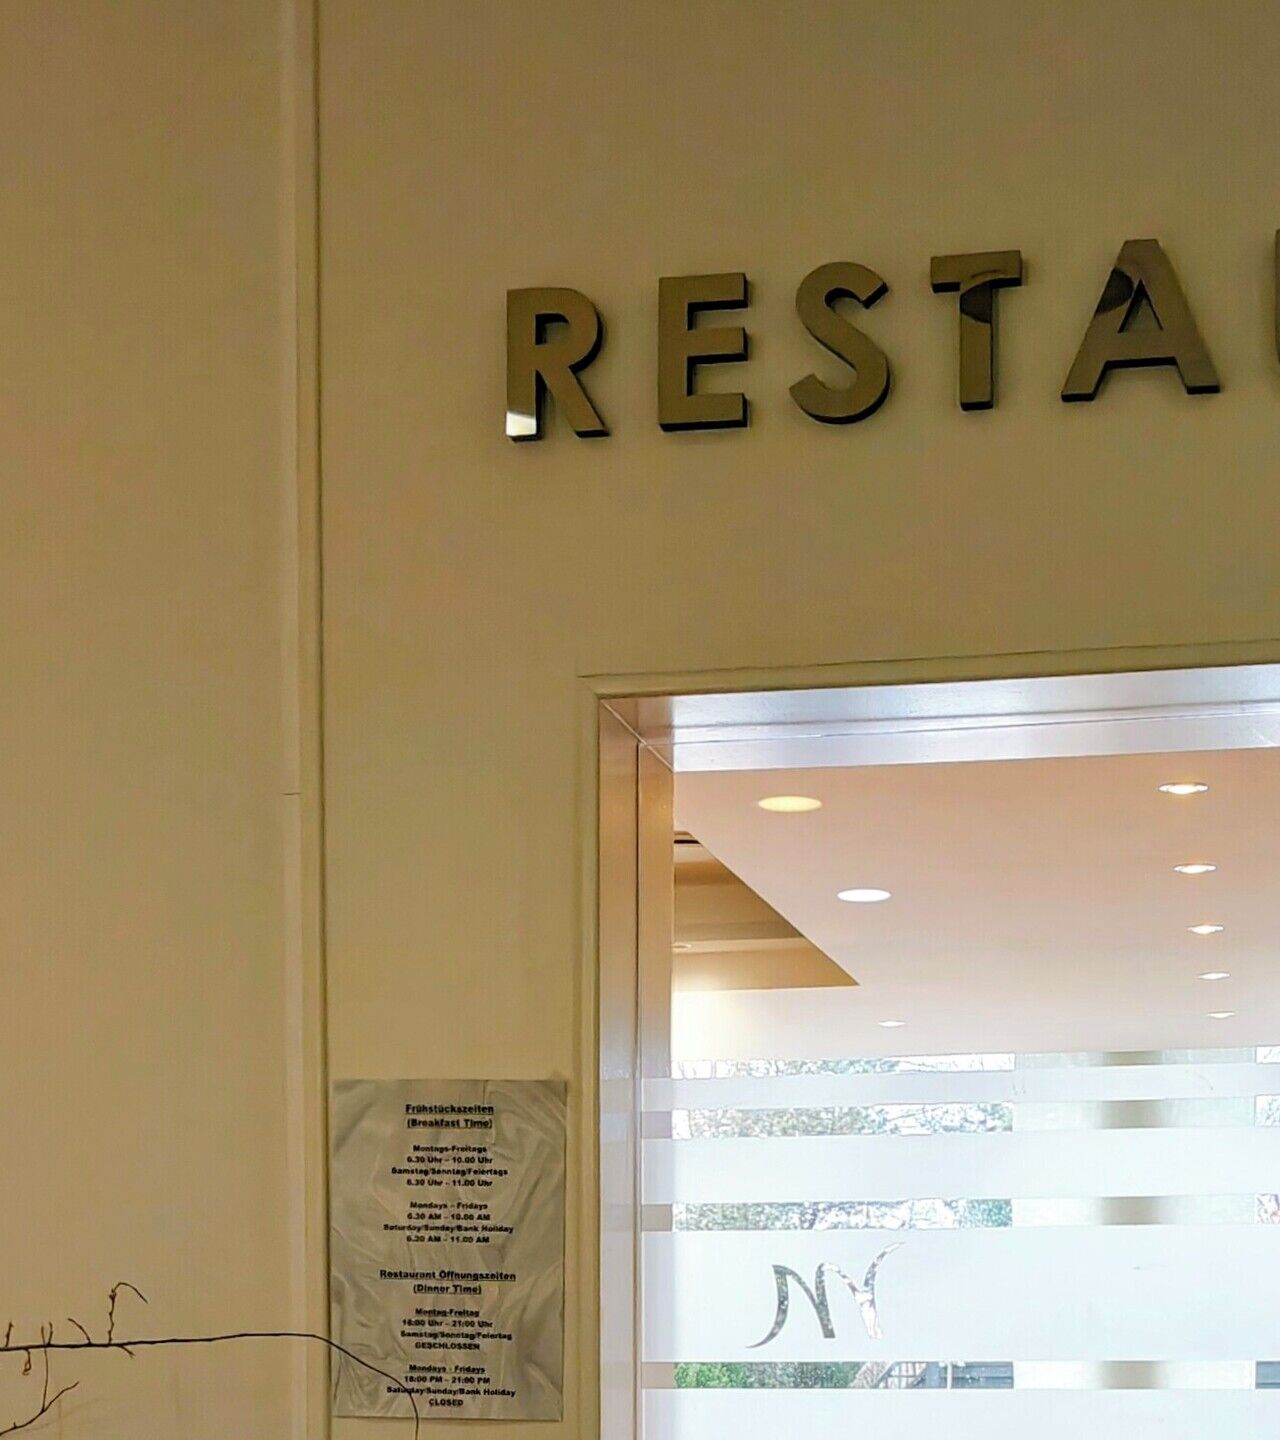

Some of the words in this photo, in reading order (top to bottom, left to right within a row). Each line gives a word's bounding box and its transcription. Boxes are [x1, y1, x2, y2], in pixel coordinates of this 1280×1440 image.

[405, 1104, 495, 1115] Frühstückszeiten
[407, 1118, 460, 1129] (Breakfast
[463, 1118, 493, 1129] Time)
[456, 1202, 489, 1210] Fridays
[380, 1269, 436, 1280] Restaurant
[413, 1283, 451, 1294] (Dinner
[453, 1283, 482, 1295] Time)
[414, 1341, 481, 1350] GESCHLOSSEN
[453, 1365, 486, 1374] Fridays
[428, 1398, 464, 1407] CLOSED
